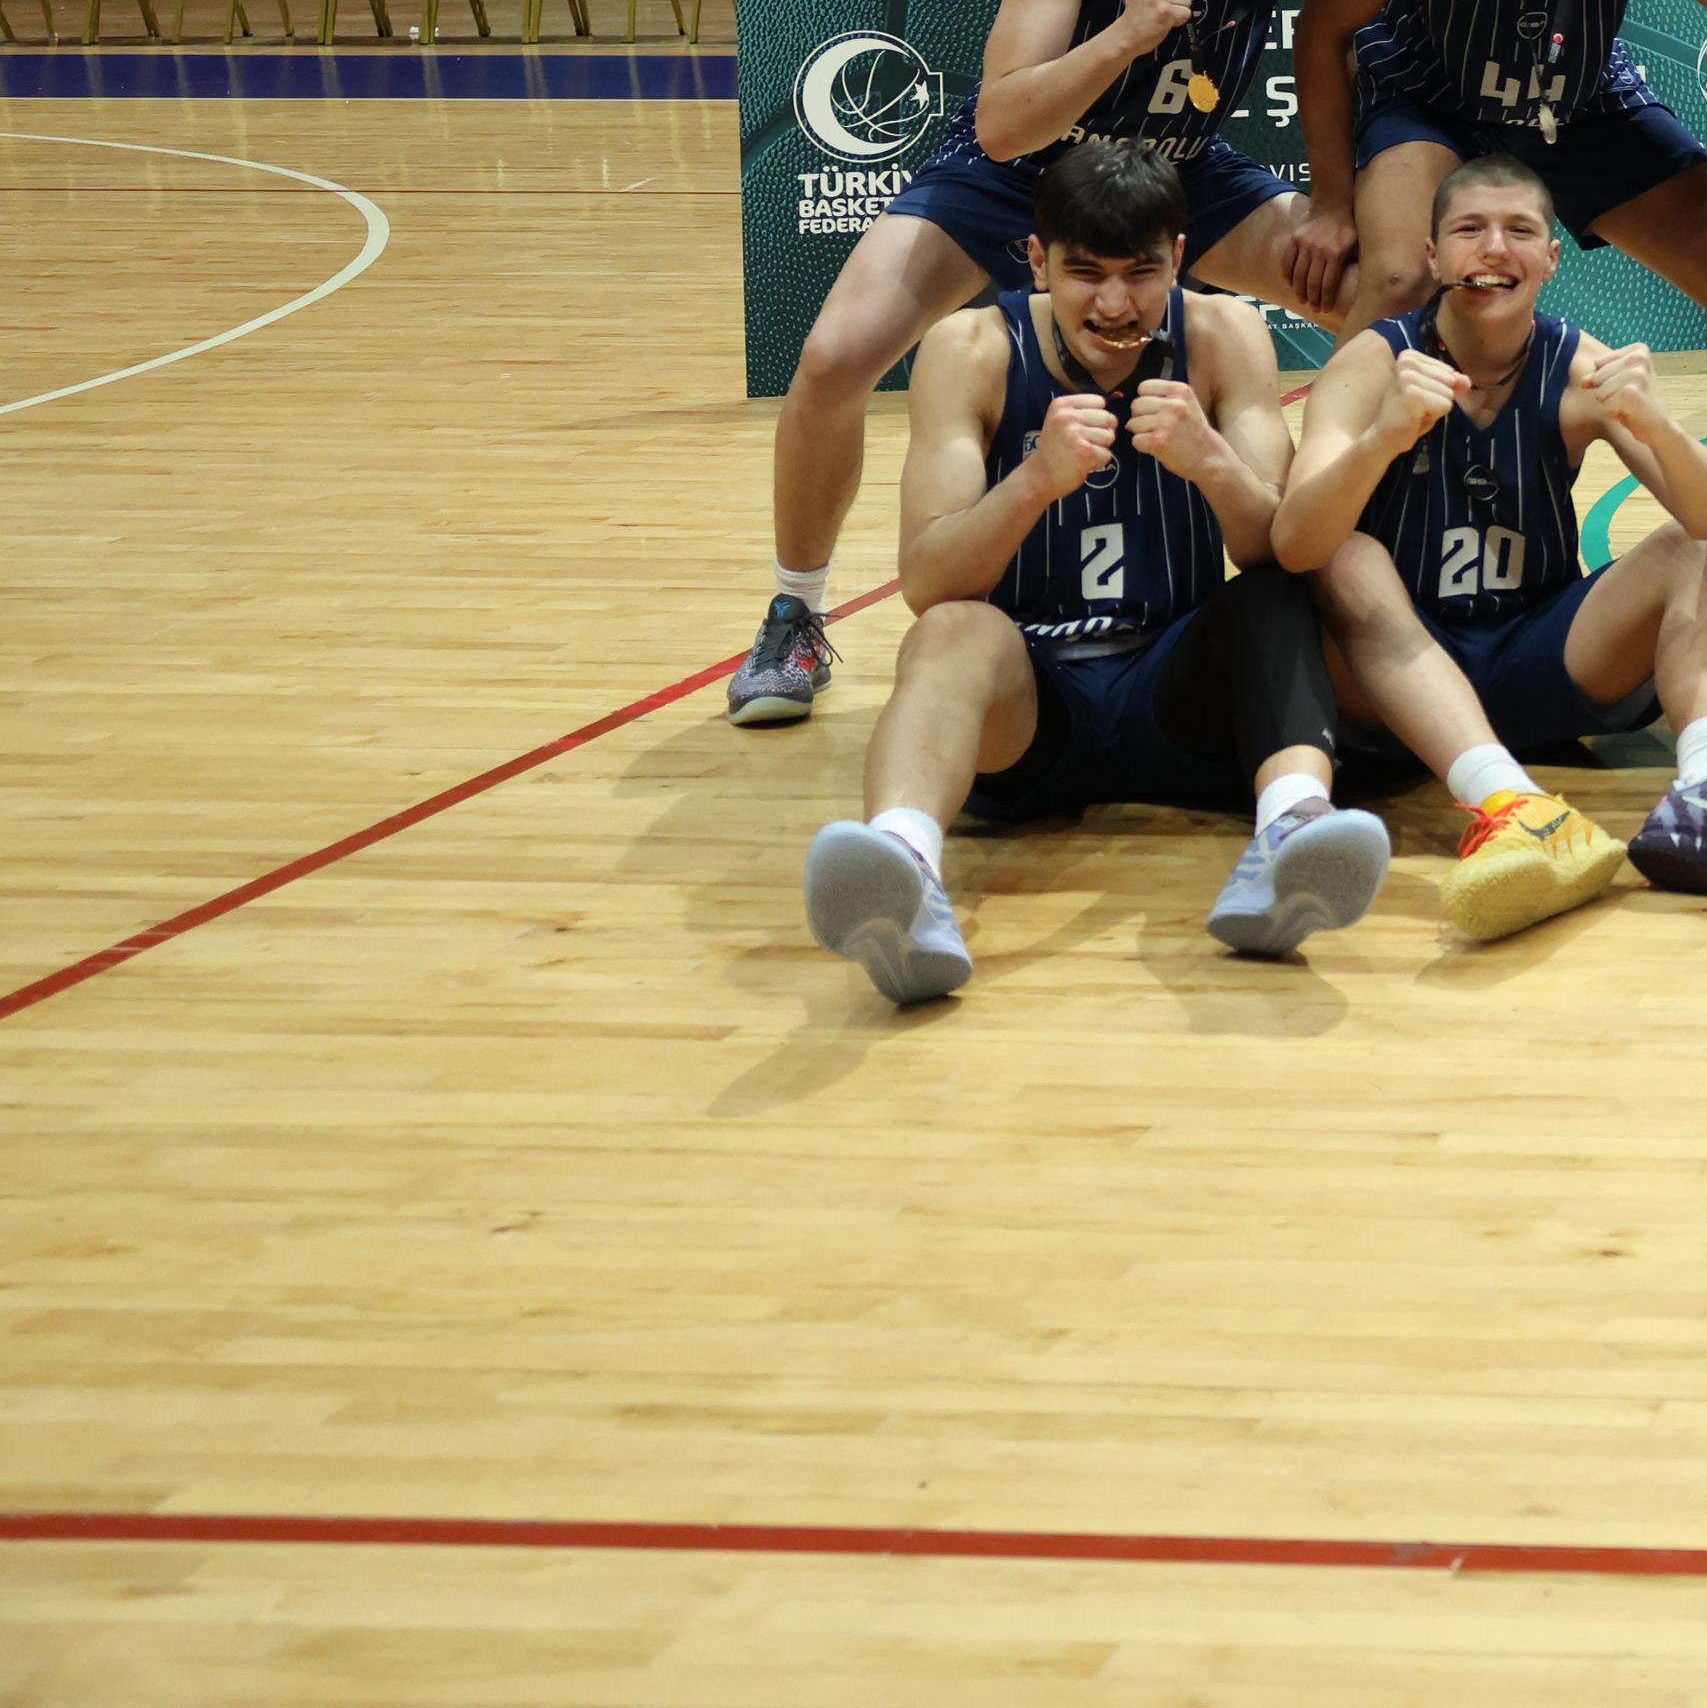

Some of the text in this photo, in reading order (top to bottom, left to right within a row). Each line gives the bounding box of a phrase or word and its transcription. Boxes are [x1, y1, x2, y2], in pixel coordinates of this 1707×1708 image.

[1147, 59, 1193, 115] 6
[1480, 59, 1567, 104] 44
[1080, 522, 1125, 600] 2
[1438, 524, 1526, 598] 20
